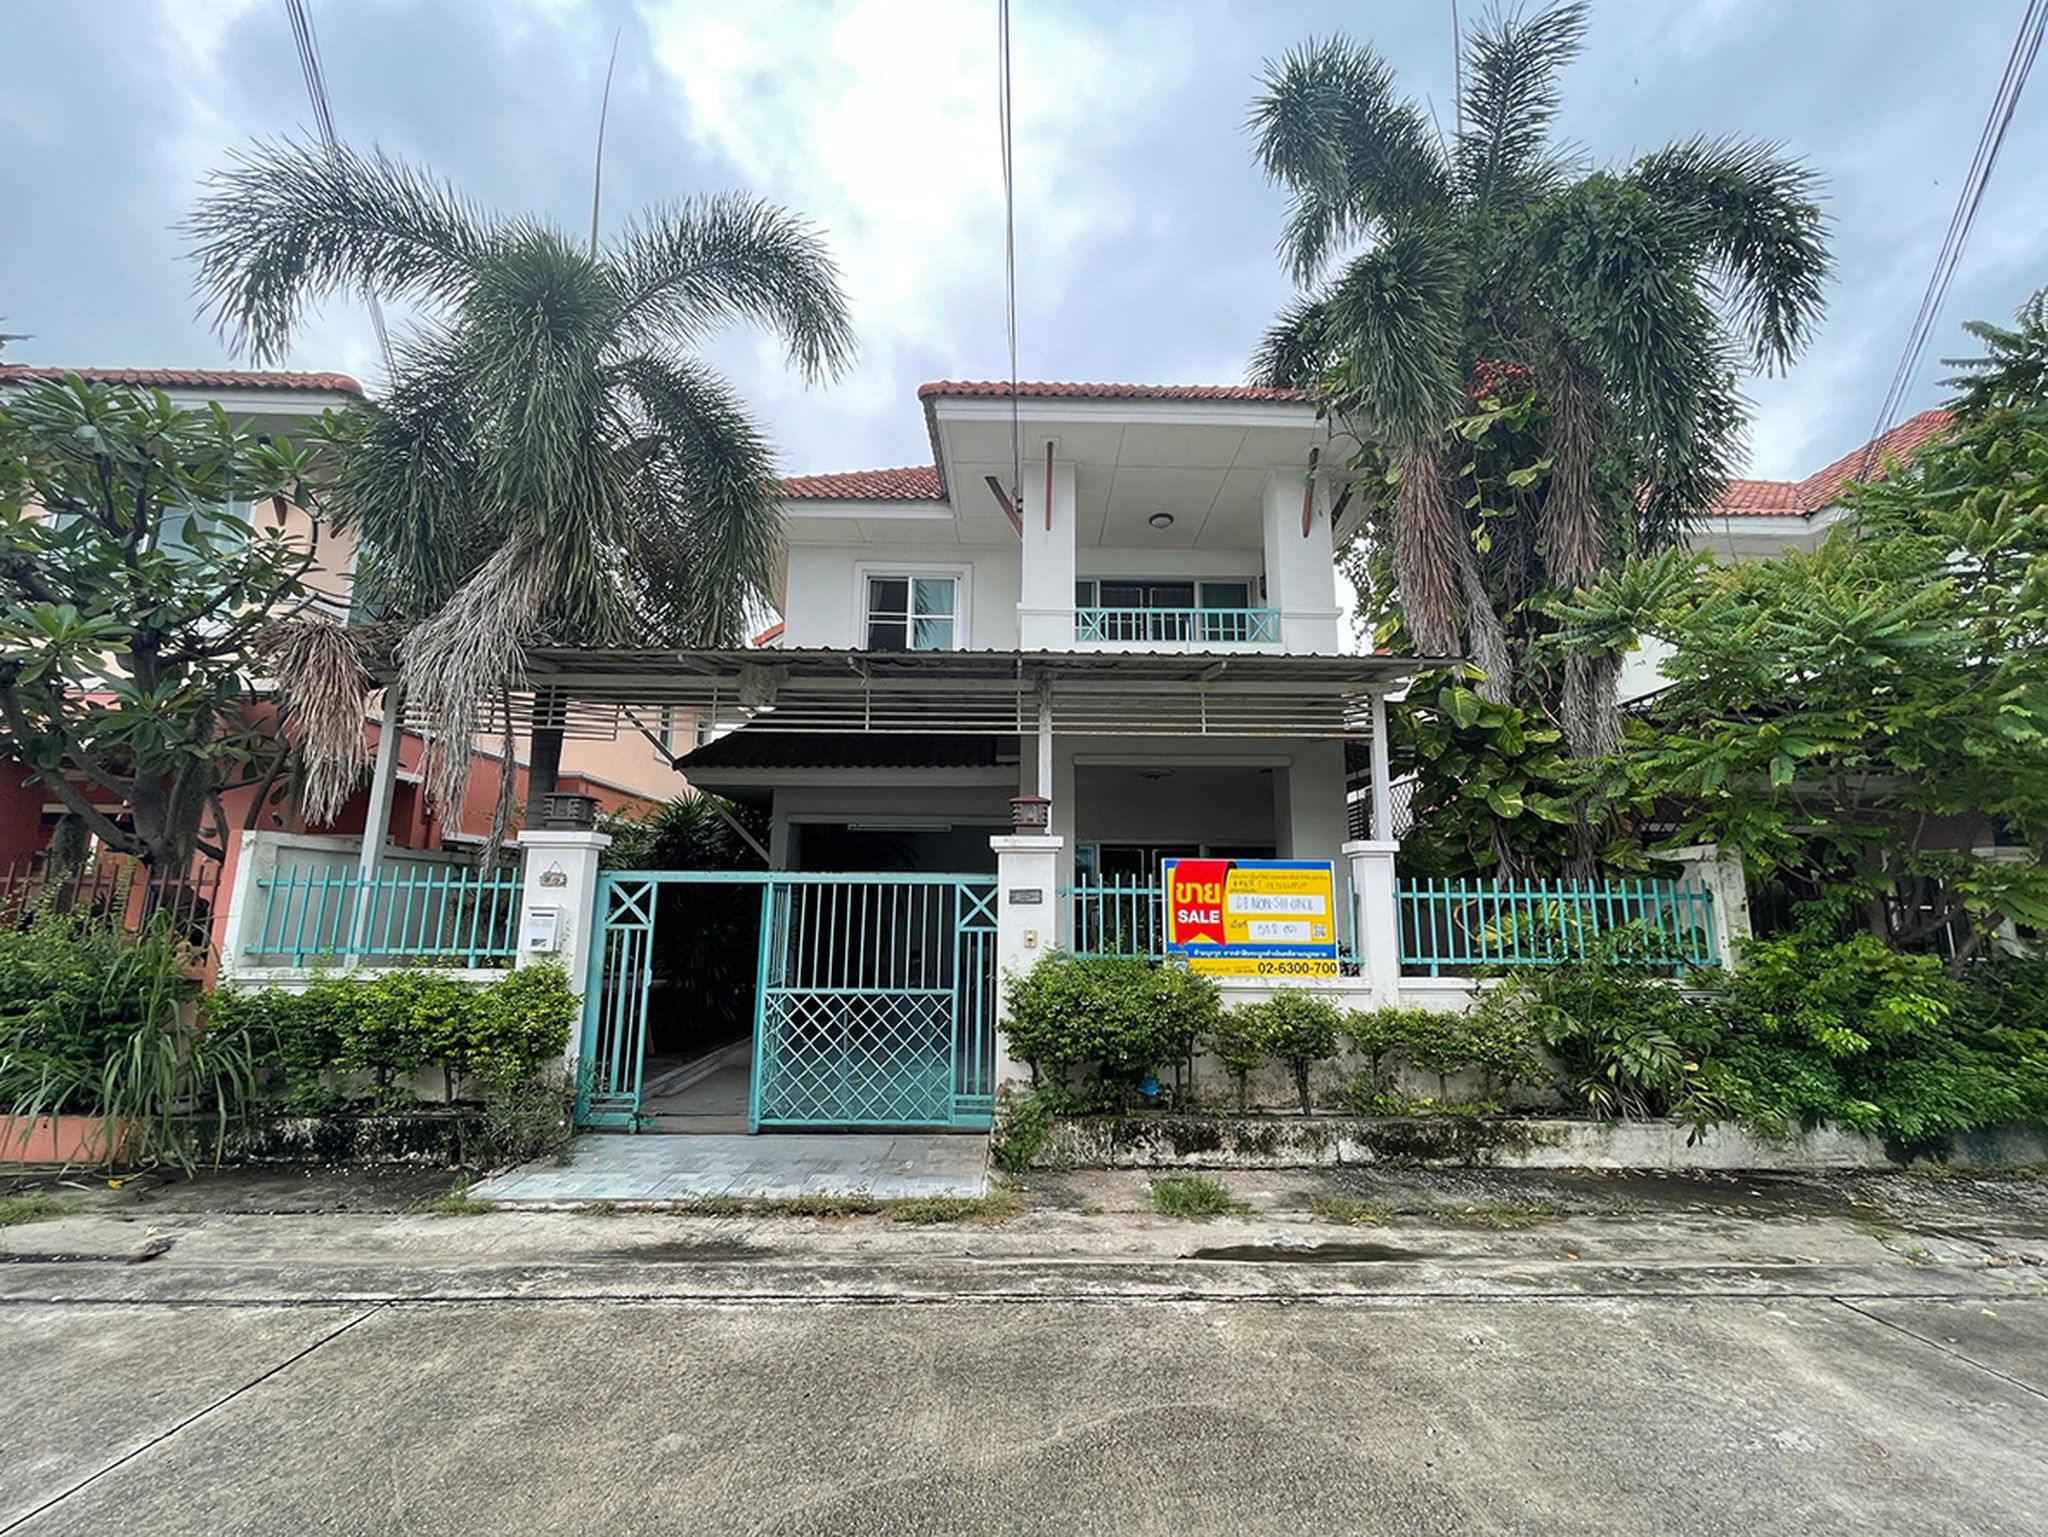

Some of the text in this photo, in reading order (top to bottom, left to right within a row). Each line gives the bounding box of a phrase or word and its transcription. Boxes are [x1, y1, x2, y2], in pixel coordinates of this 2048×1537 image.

[1175, 882, 1220, 904] ขาย
[1177, 909, 1220, 924] SALE
[1257, 962, 1338, 975] 02-6300-700
